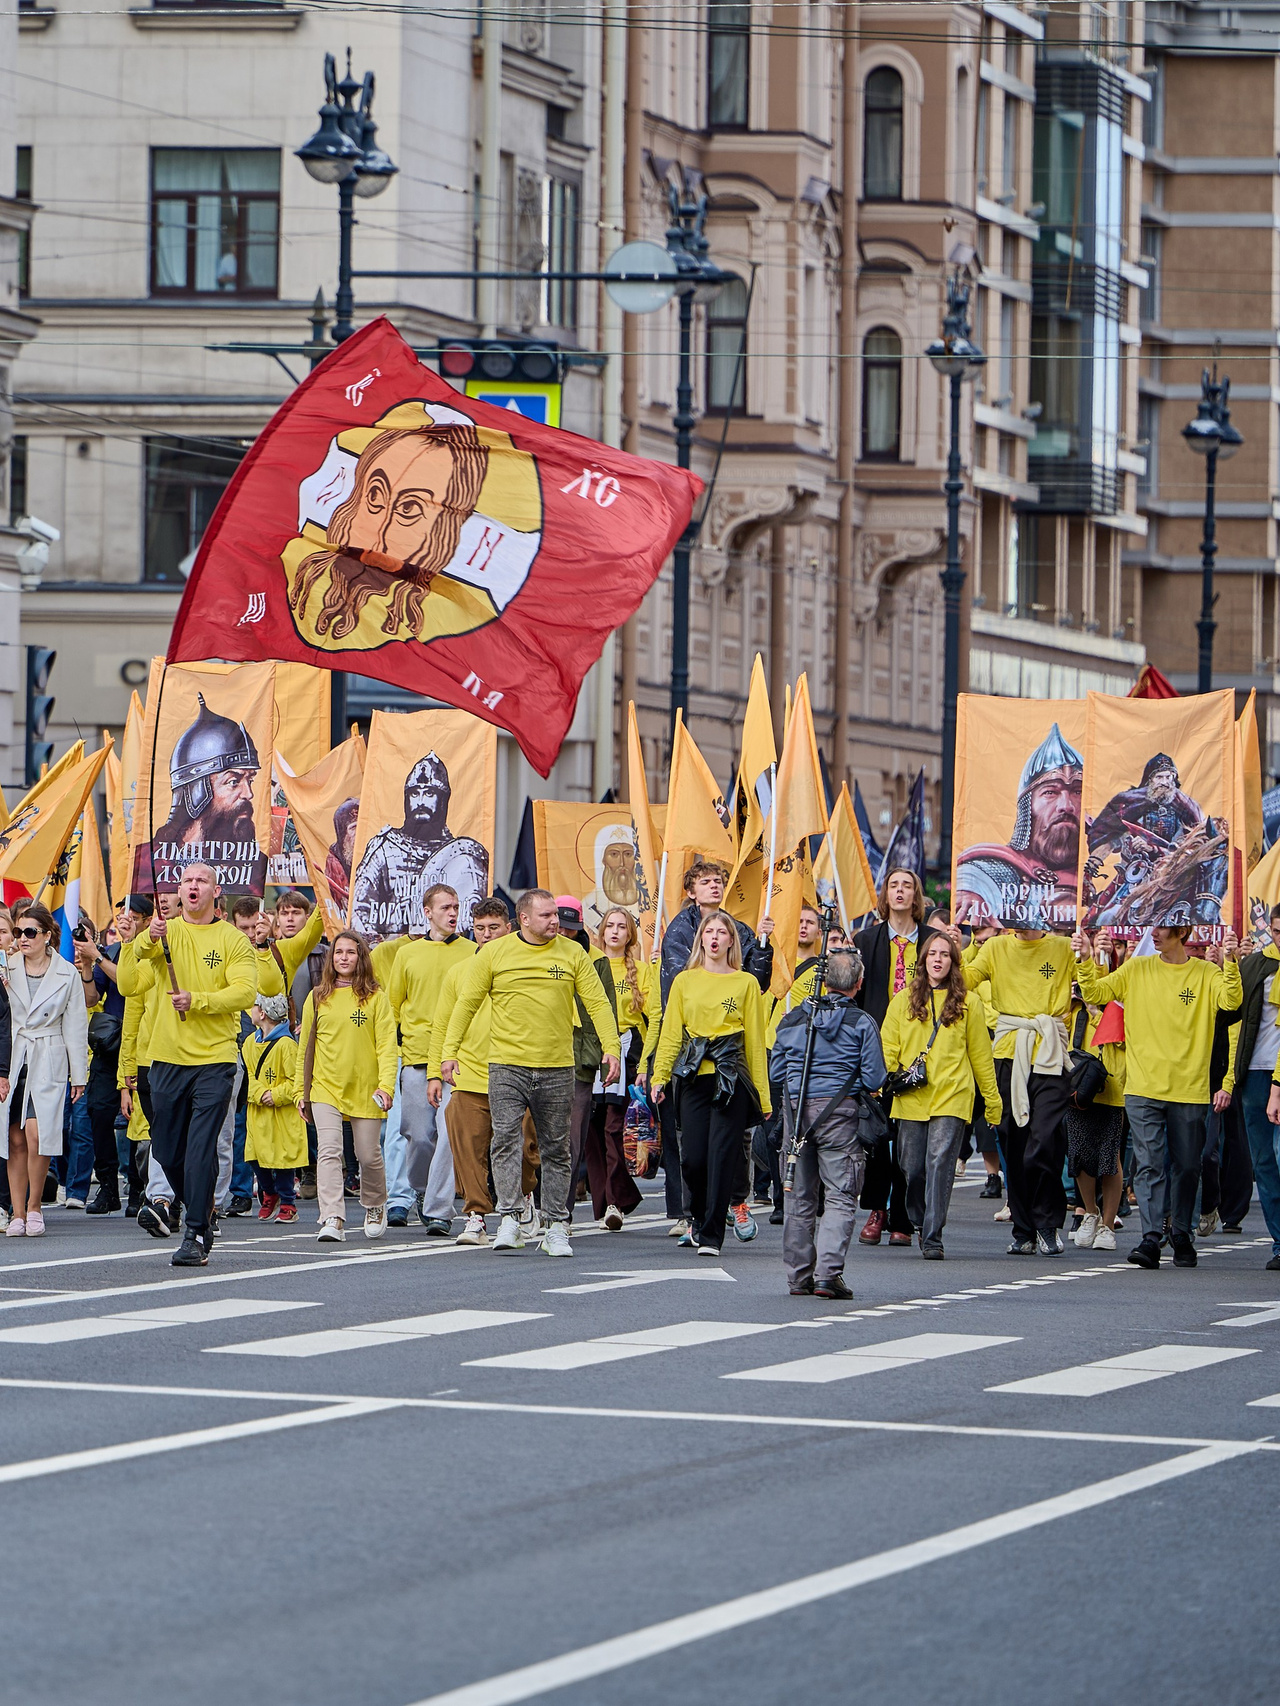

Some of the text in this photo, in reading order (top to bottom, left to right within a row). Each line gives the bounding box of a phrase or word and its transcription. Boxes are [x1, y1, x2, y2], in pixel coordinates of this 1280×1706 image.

[154, 839, 260, 861] ДМИТРИЙ
[156, 863, 253, 885] ДОКОЙ
[1001, 882, 1055, 901] ЮРИЙ
